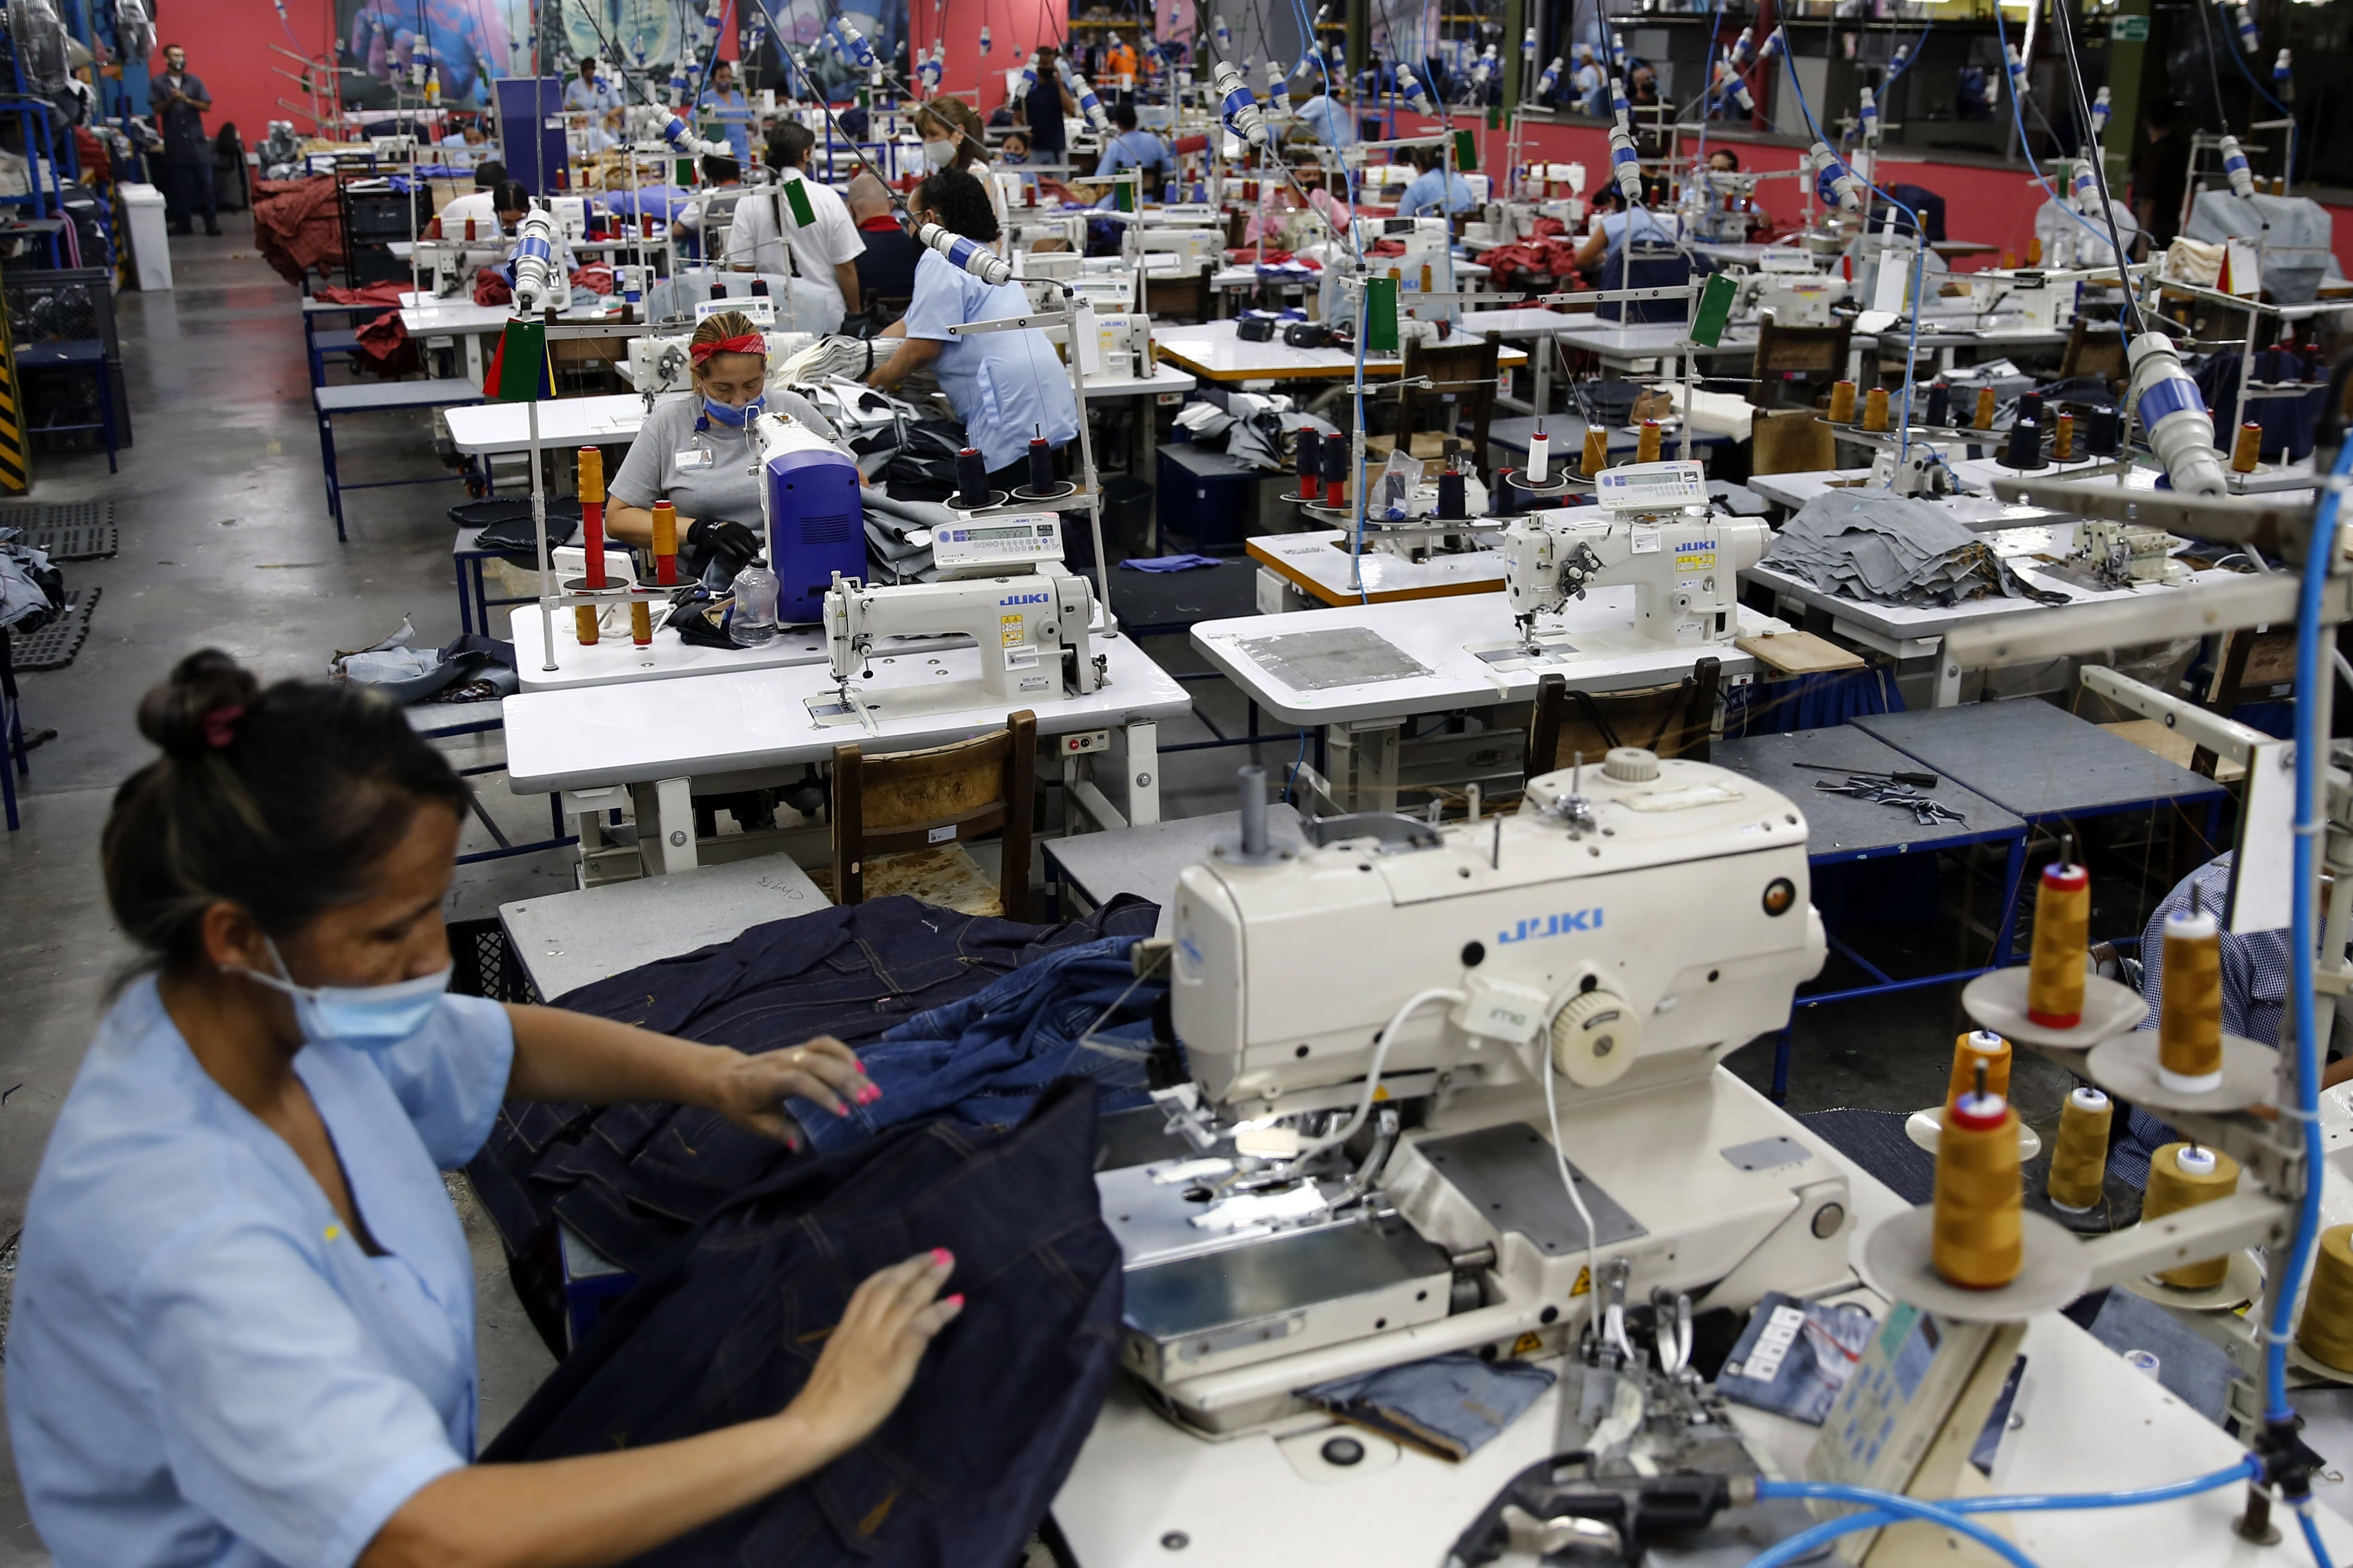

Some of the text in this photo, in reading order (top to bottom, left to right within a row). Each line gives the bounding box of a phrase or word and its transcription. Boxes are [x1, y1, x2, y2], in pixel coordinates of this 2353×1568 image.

[1675, 540, 1715, 552] JUKI
[1000, 593, 1049, 606] JUKI
[1498, 908, 1603, 944] JUKI
